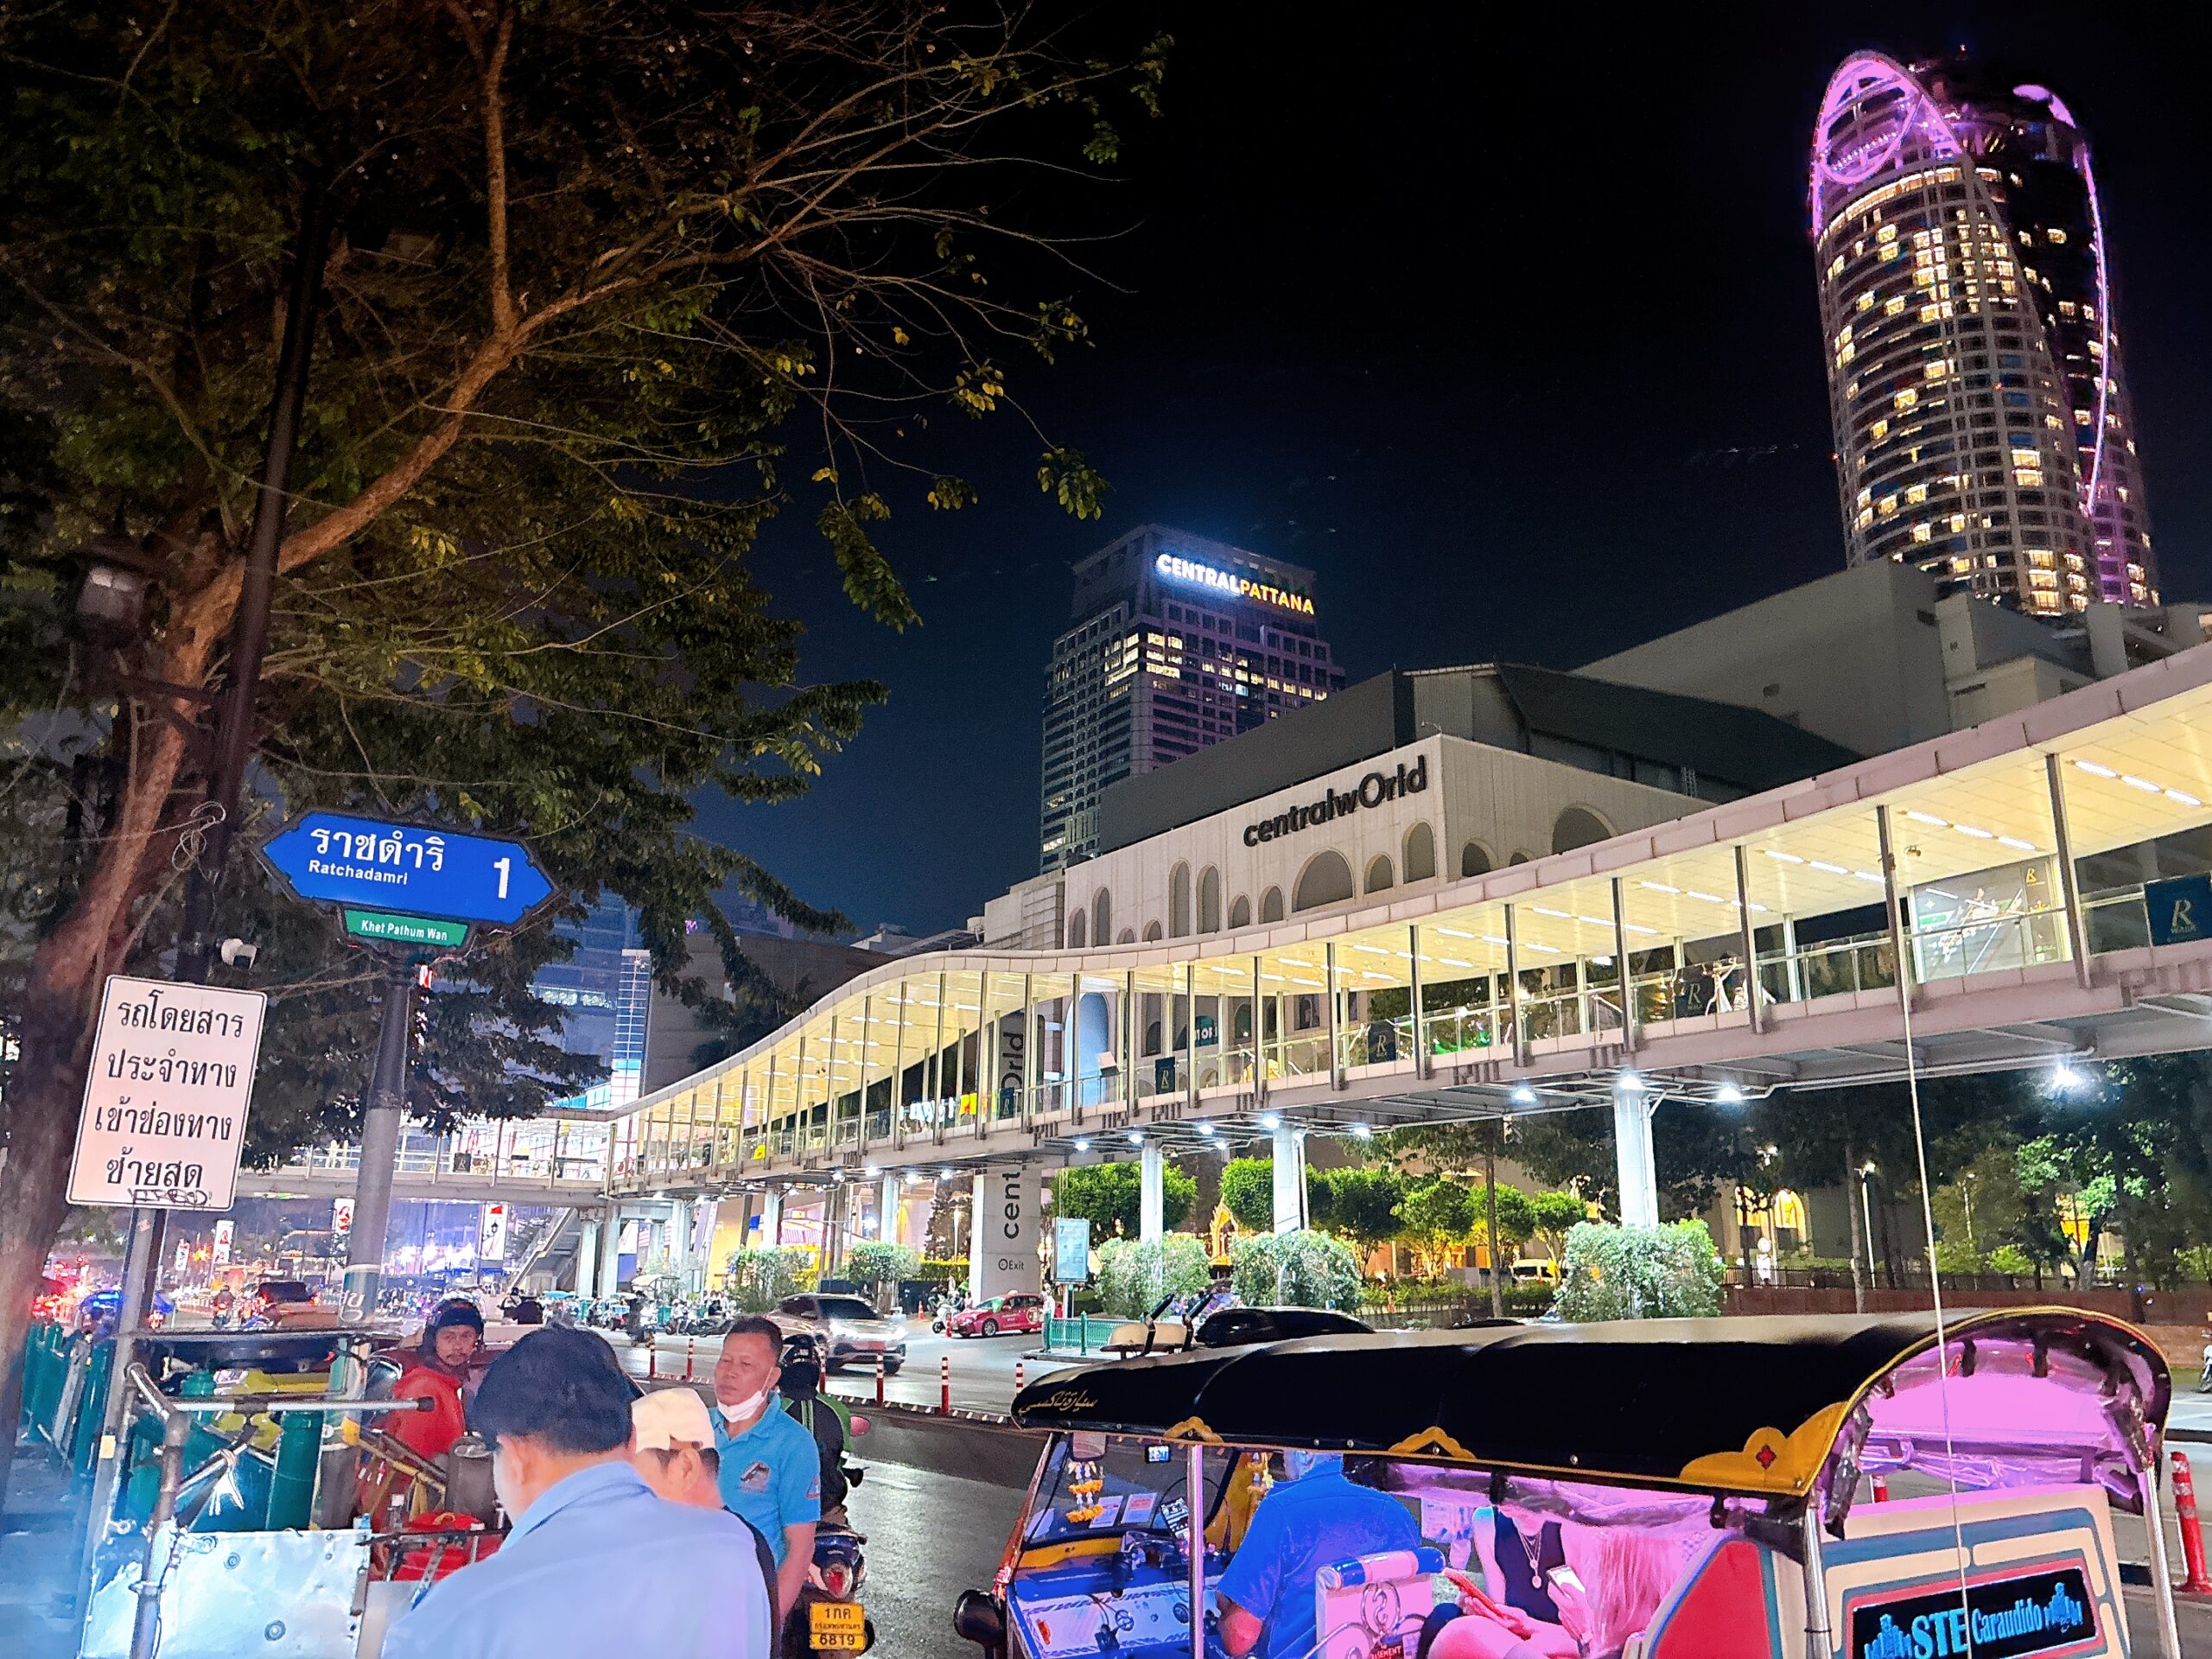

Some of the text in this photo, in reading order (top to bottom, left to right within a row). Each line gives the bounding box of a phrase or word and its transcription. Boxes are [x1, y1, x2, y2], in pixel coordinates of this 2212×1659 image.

[310, 830, 445, 871] ราชดำริ
[308, 859, 408, 886] Ratchadamri
[493, 857, 511, 899] 1
[361, 919, 448, 942] Khet Pathum Wan
[118, 989, 244, 1038] รถโดยสาร
[108, 1048, 237, 1087] ประจำทาง
[95, 1096, 232, 1141] เข้าช่องทาง
[1008, 1262, 1025, 1270] Exit
[820, 1633, 855, 1645] 6819
[1911, 1608, 1971, 1659] STE
